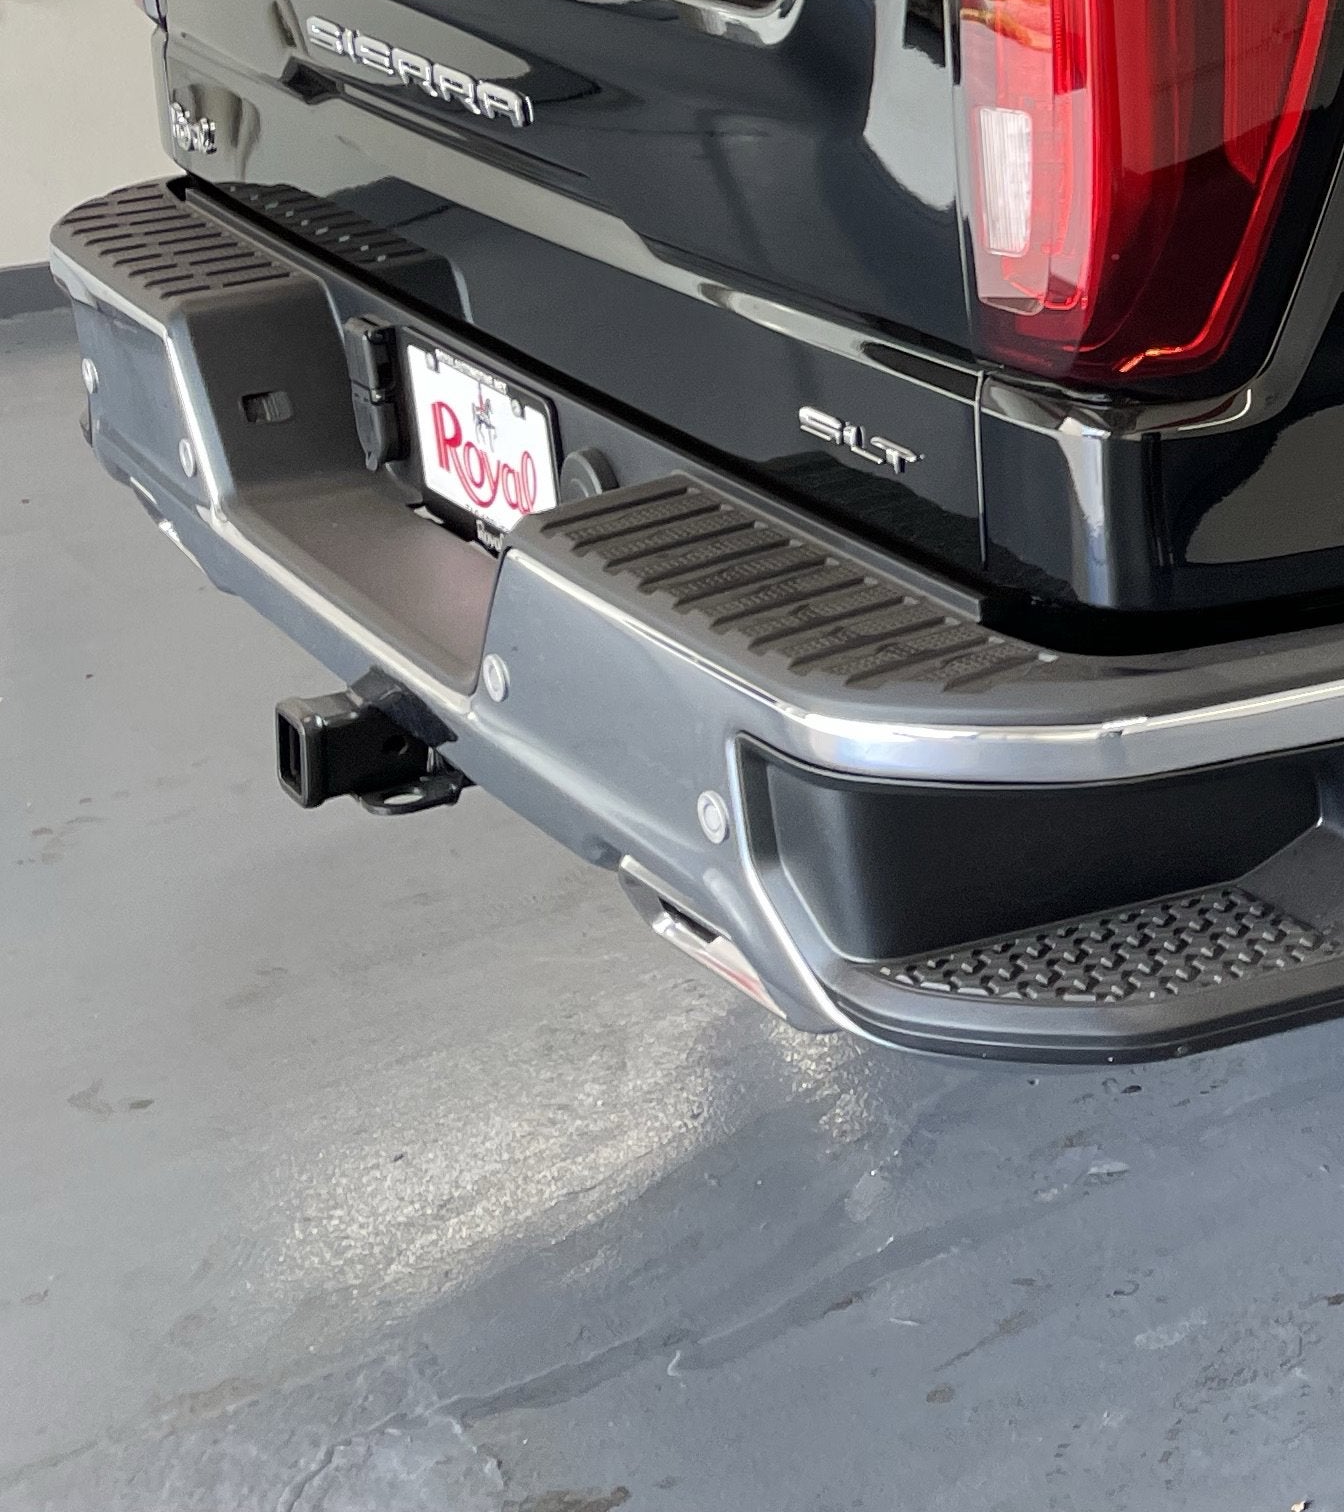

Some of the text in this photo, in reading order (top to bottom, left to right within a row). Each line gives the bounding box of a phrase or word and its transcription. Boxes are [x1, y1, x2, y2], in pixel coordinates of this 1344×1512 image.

[306, 15, 534, 128] SIERRA
[431, 401, 537, 515] Royal
[798, 405, 924, 475] SLT
